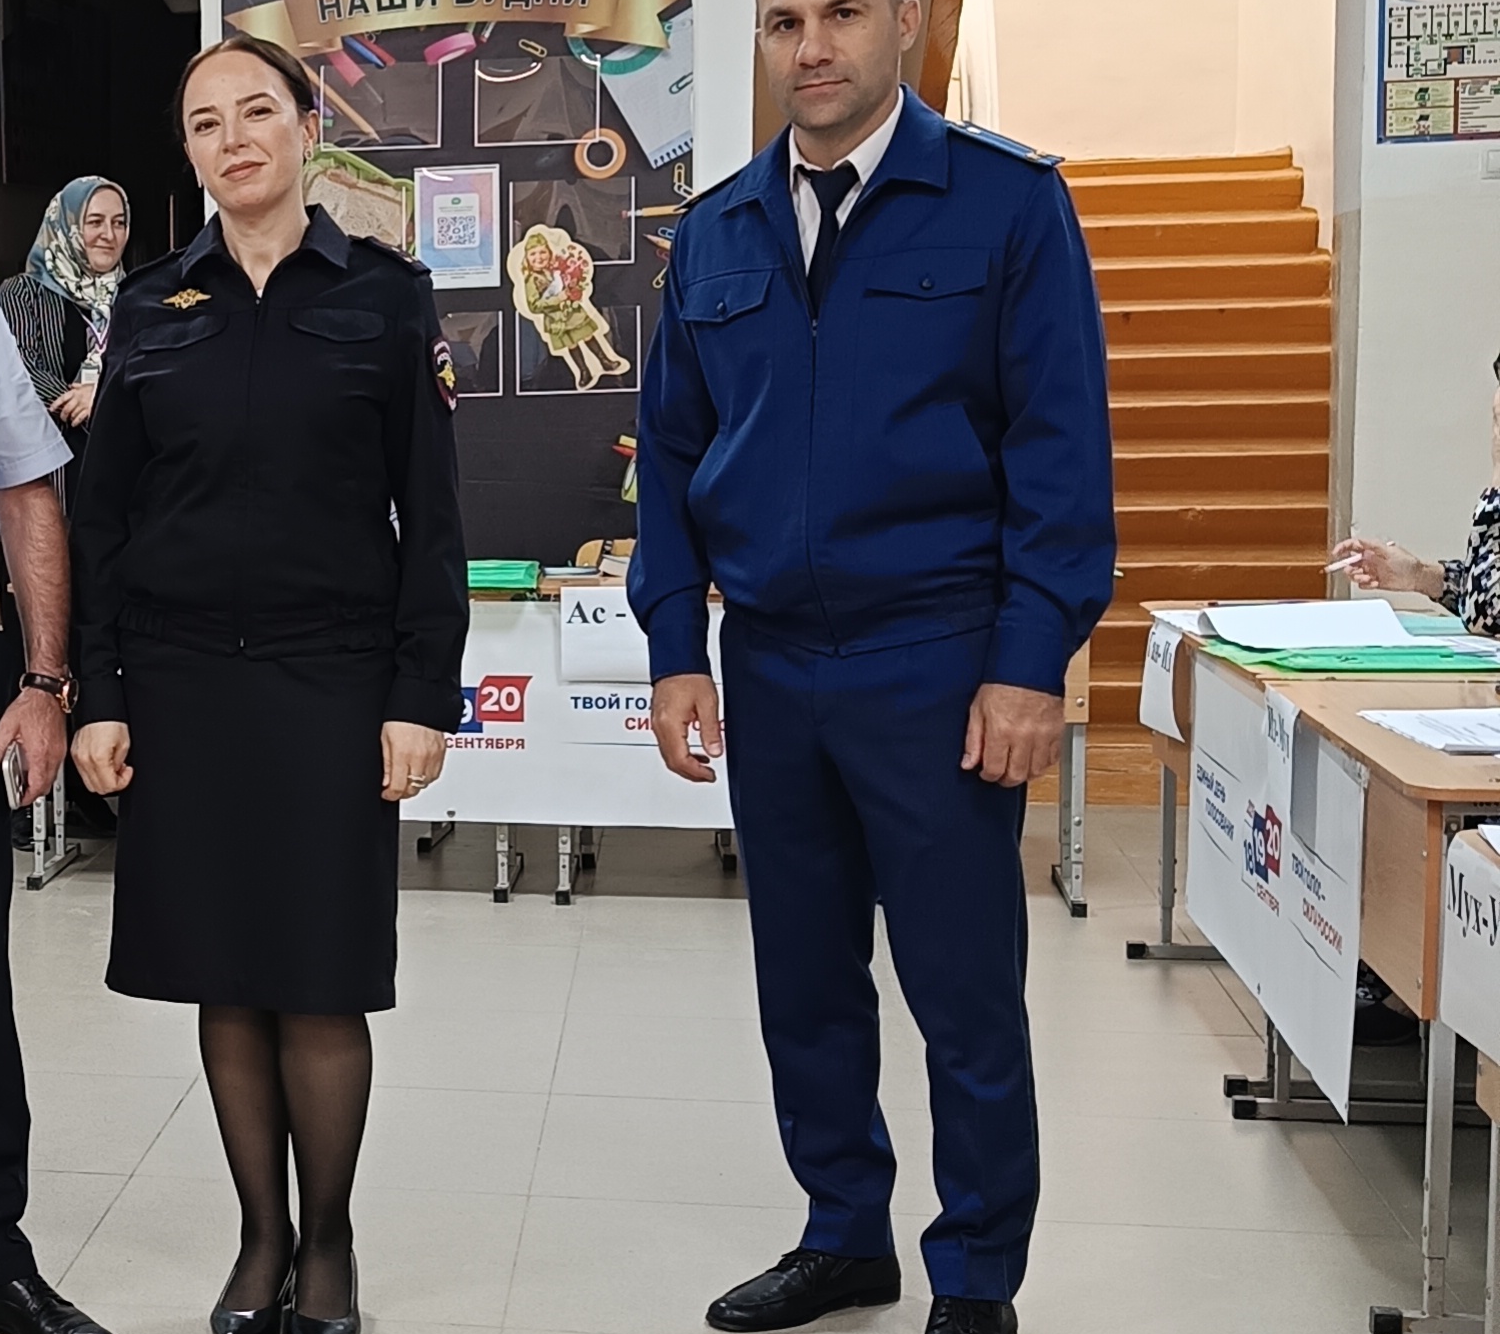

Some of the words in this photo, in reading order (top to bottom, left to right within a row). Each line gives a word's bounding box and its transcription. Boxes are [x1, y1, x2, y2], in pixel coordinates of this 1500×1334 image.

[566, 601, 606, 624] Ас
[480, 685, 521, 713] 20
[571, 693, 620, 710] ТВОЙ
[625, 717, 653, 730] СИ
[445, 736, 525, 750] СЕНТЯБРЯ
[1254, 828, 1266, 866] 19
[1265, 819, 1280, 860] 20
[1243, 838, 1255, 876] 18
